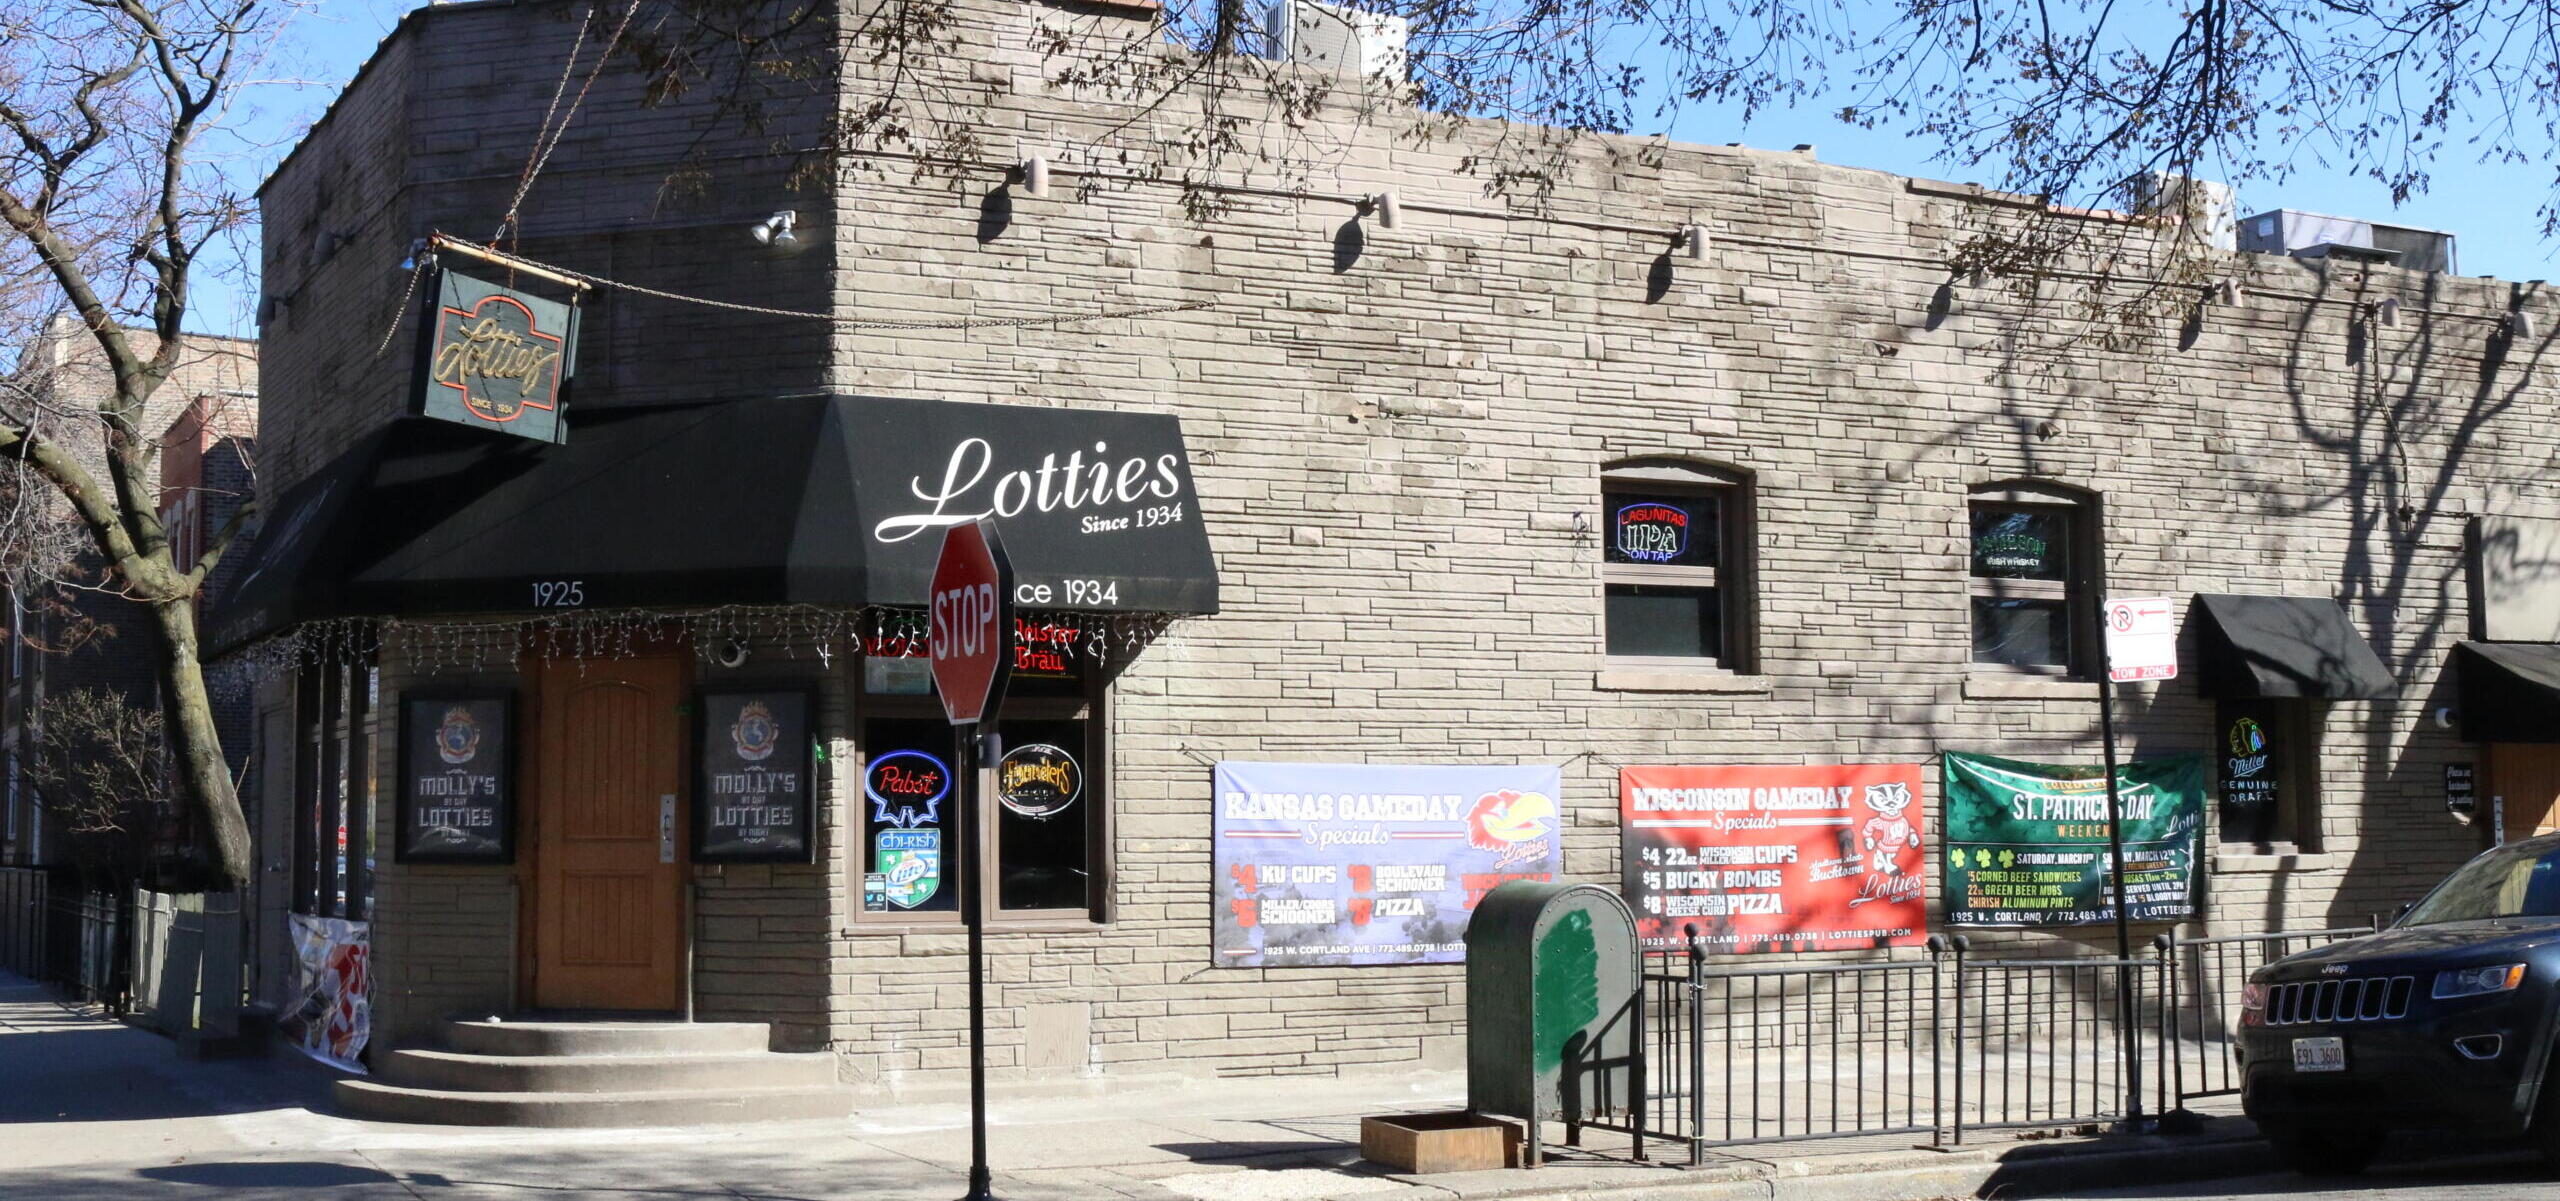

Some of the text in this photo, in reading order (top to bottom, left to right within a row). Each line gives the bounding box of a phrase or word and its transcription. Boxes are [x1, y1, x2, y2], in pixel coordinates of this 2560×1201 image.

[434, 318, 560, 396] Lotties
[874, 438, 1180, 542] Lotties
[1081, 502, 1183, 534] Since 1934
[1621, 508, 1686, 527] LAGUNITAS
[1626, 524, 1677, 552] IPA
[1630, 550, 1673, 561] ON TAP
[532, 581, 584, 607] 1925
[1063, 579, 1118, 605] 1934
[935, 583, 995, 661] STOP
[2115, 666, 2169, 679] TOW ZONE
[2228, 754, 2268, 776] Miller
[419, 775, 495, 796] MOLLY'S
[714, 773, 796, 794] MOLLY'S
[880, 766, 938, 795] Pabst
[1224, 791, 1463, 822] KANSAS GAMEDAY
[1631, 785, 1853, 811] WISCONSIN GAMEDAY
[2013, 794, 2038, 820] ST.
[2126, 794, 2155, 820] DAY
[418, 807, 493, 827] LOTTIES
[714, 805, 793, 827] LOTTIES
[1712, 811, 1777, 835] Specials
[1305, 821, 1390, 851] Specials
[2058, 824, 2110, 838] WEEKEN
[1642, 847, 1660, 866] $4
[1699, 846, 1755, 857] WISCONSIN
[1755, 846, 1798, 864] CUPS
[2058, 853, 2083, 865] MARCH
[2135, 851, 2158, 862] MARCH
[1262, 866, 1287, 883] KU
[1292, 865, 1336, 883] CUPS
[1375, 865, 1446, 879] BOULEVARD
[1643, 870, 1782, 889] $5 BUCKY BOMBS
[1976, 871, 2008, 882] CORNED
[2010, 871, 2031, 882] BEEF
[2033, 871, 2082, 882] SANDWICHES
[1375, 878, 1446, 893] SCHOONER
[1849, 873, 1922, 908] Lotties
[1985, 885, 2013, 896] GREEN
[2015, 885, 2037, 895] BEER
[2039, 885, 2062, 895] MUGS
[1261, 899, 1336, 912] MILLER/COORS
[1375, 899, 1425, 917] PIZZA
[1643, 894, 1783, 914] $8 WISCONSIN PIZZA
[1666, 905, 1726, 917] CHEESE CURD
[1968, 897, 2074, 908] CHIRISH ALUMINUM PINTS
[1260, 910, 1336, 925] SCHOONER
[1951, 912, 1973, 922] 1925
[1641, 937, 1664, 946] 1925
[1669, 936, 1681, 945] W.
[1751, 933, 1818, 942] 773.489.0738
[1829, 929, 1911, 939] LOTTIESPUB.COM
[1264, 943, 1467, 955] 1925 W. CORTLAND AVE 773.489.0738 LOTTI
[2321, 964, 2349, 976] Jeep
[2296, 1048, 2313, 1065] E91
